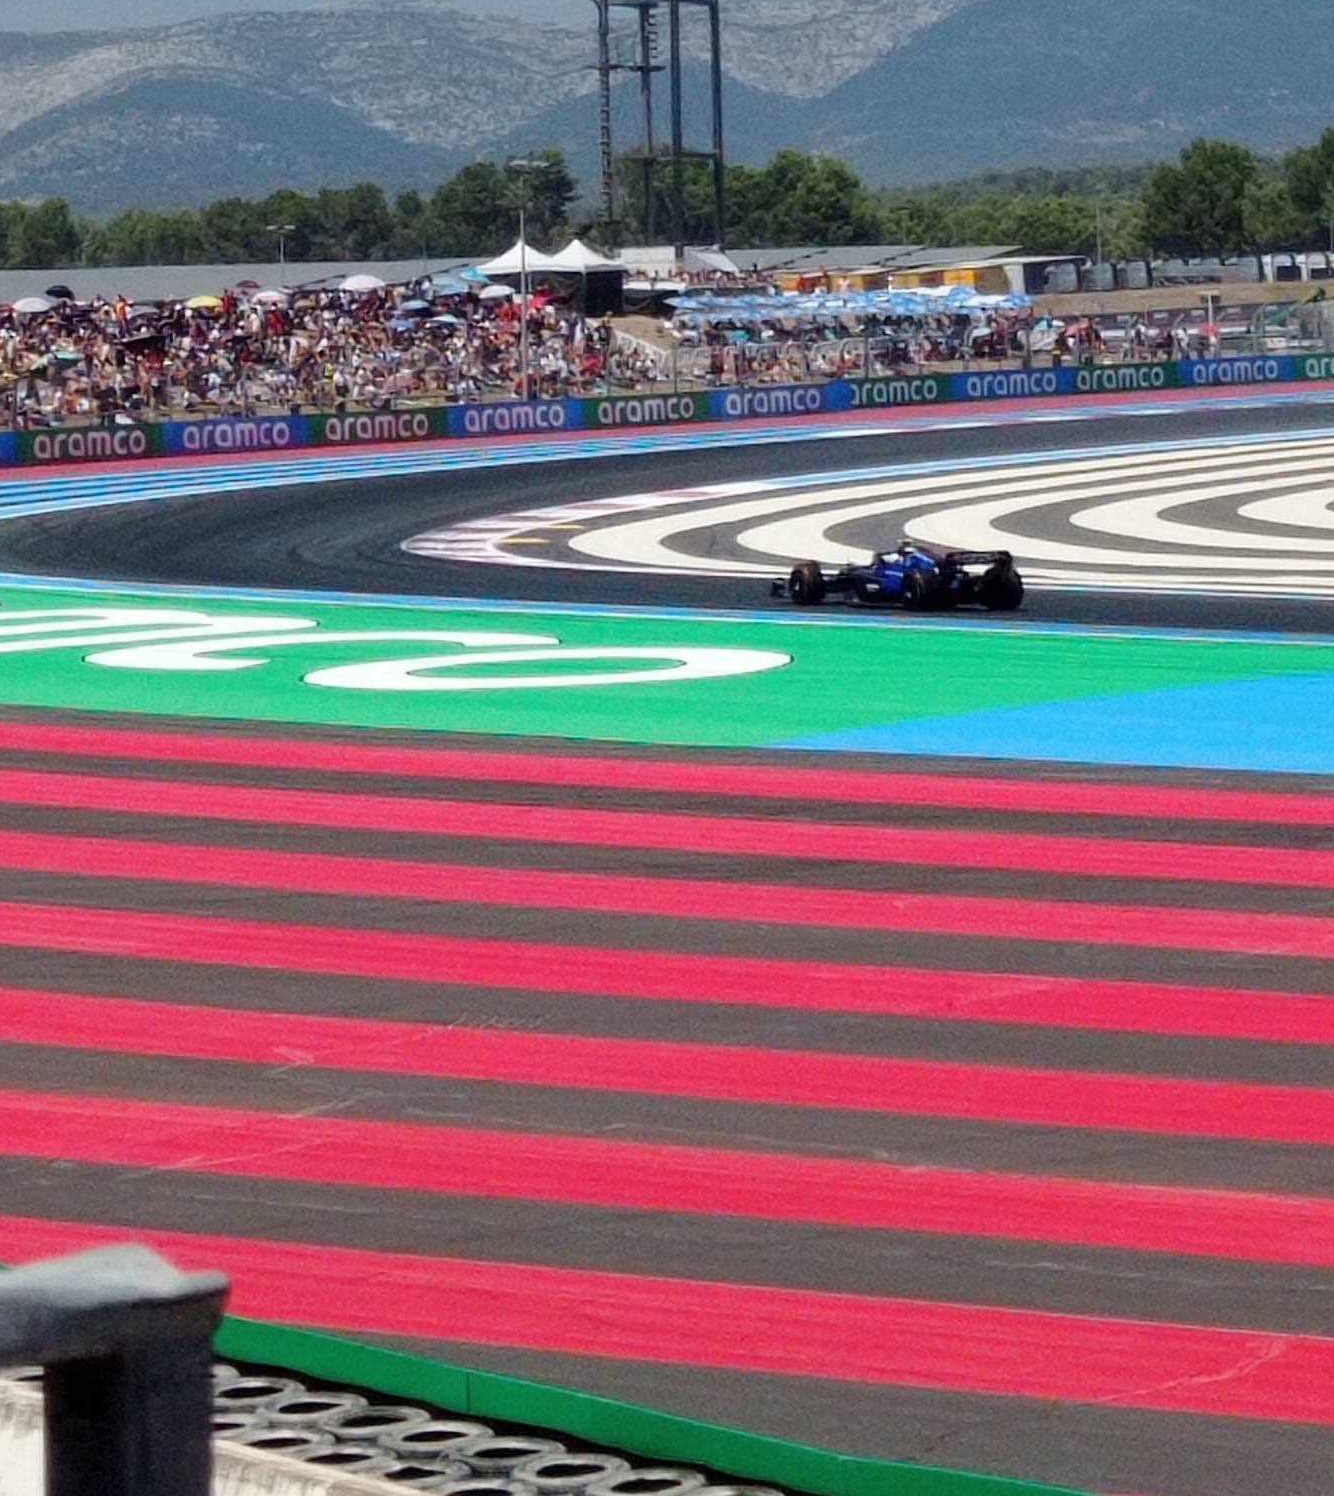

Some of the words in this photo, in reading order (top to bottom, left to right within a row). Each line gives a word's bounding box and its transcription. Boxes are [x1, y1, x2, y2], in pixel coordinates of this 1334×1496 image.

[967, 370, 1056, 398] aramco
[1076, 363, 1164, 391] aramco
[1193, 358, 1278, 382] aramco
[598, 397, 694, 423] aramco
[725, 388, 821, 414] aramco
[325, 411, 429, 441] aramco
[466, 404, 564, 433] aramco
[33, 428, 145, 459] aramco
[183, 419, 289, 450] aramco
